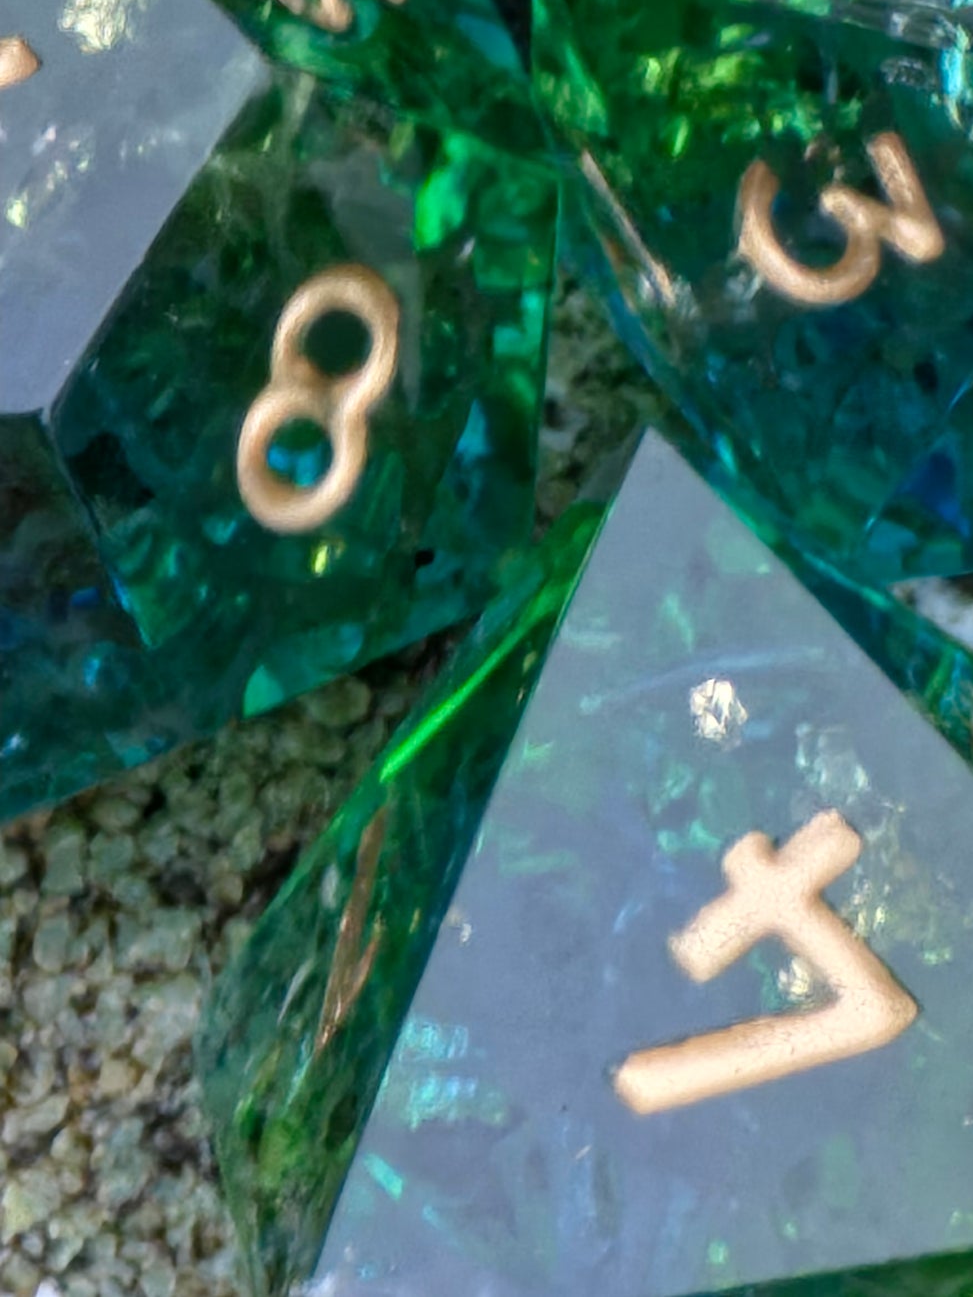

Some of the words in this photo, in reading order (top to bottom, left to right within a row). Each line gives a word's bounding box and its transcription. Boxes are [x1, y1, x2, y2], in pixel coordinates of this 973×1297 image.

[738, 130, 945, 304] 3
[236, 263, 400, 535] 8
[613, 808, 918, 1116] 4
